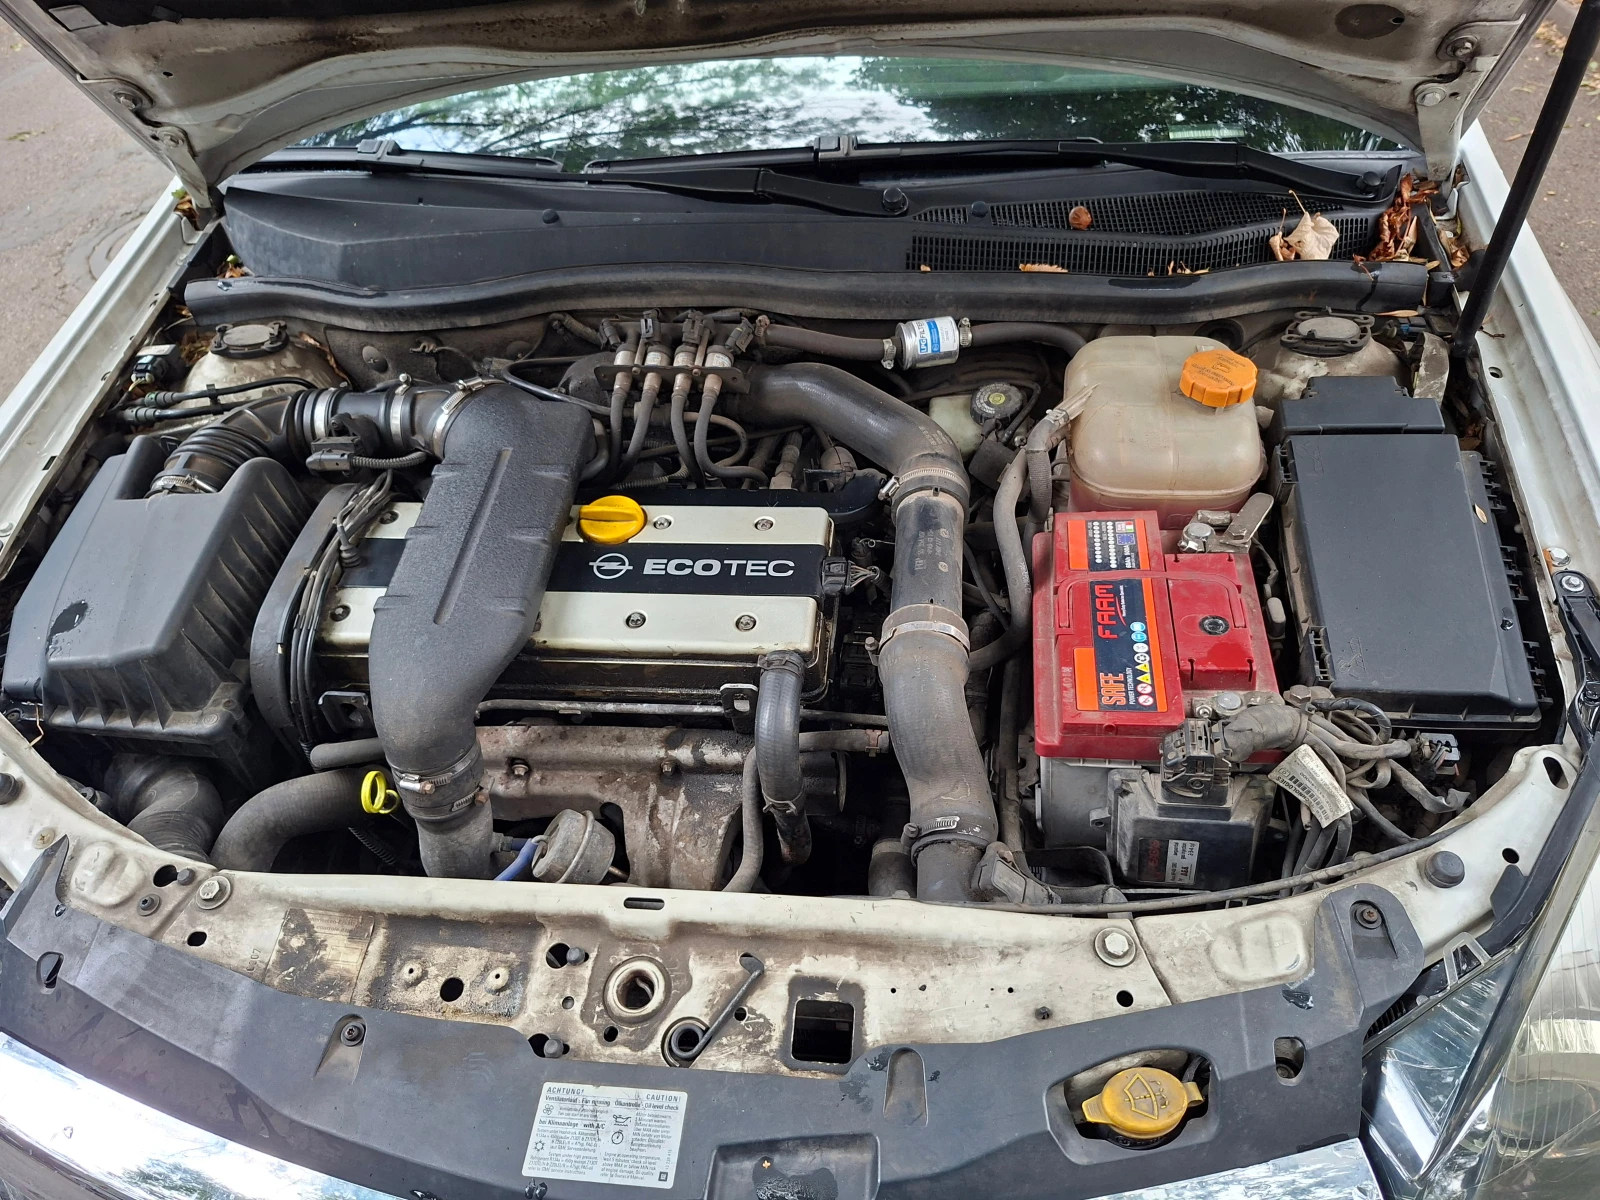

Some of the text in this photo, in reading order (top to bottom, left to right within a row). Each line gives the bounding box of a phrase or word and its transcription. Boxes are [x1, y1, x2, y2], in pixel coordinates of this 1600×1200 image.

[643, 558, 795, 577] ECOTEC
[1094, 584, 1118, 639] FAAM
[1100, 673, 1126, 706] SAFE
[1126, 667, 1134, 690] TECHNOLOGY
[547, 1087, 584, 1095] ACHTUNG!
